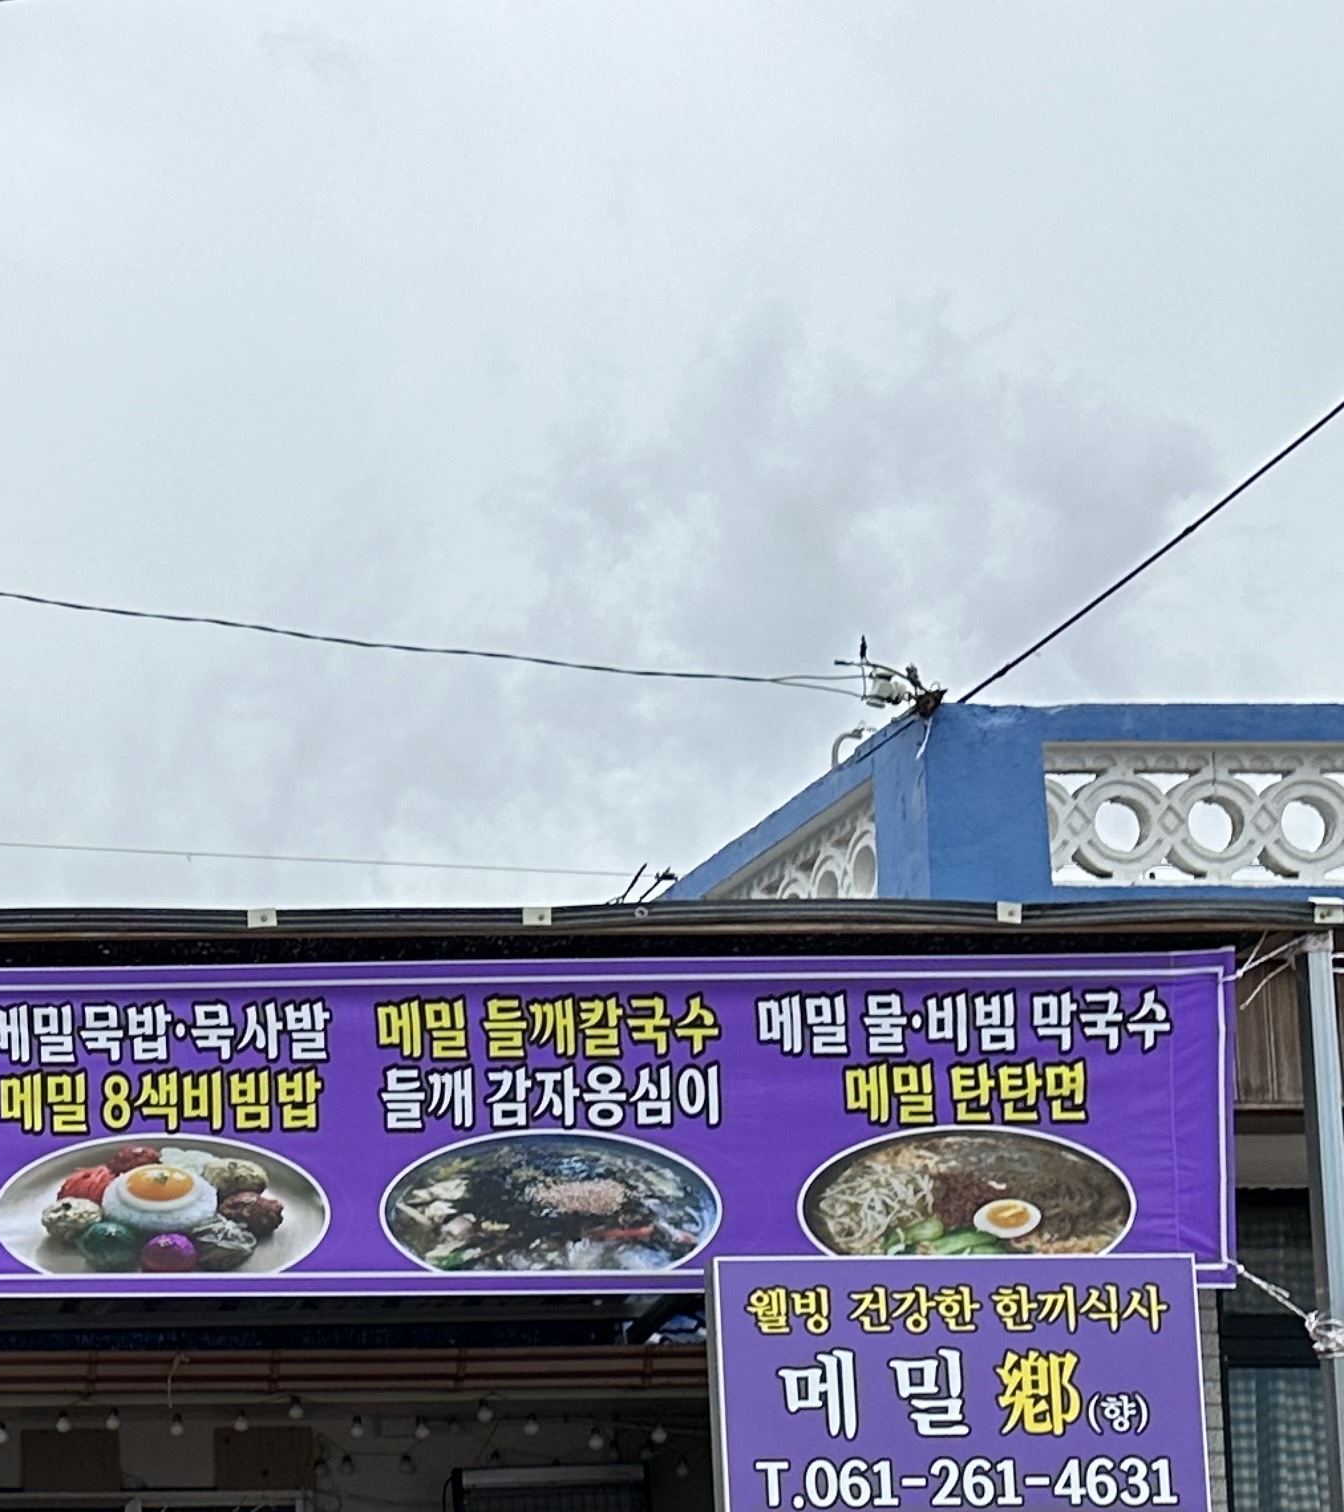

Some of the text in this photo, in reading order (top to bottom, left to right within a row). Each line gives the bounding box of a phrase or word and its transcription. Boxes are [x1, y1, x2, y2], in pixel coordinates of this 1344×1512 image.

[377, 998, 720, 1059] 메밀 들깨칼국수
[758, 995, 849, 1055] 메밀
[1033, 991, 1172, 1052] 막국수
[103, 1069, 324, 1132] 8색비빔밥
[381, 1065, 721, 1131] 들깨 감자옹심이
[845, 1061, 1088, 1127] 메밀 탄탄면
[747, 1285, 1169, 1335] 웰빙 건강한 한끼식사
[755, 1457, 1180, 1511] T.061-261-4631
